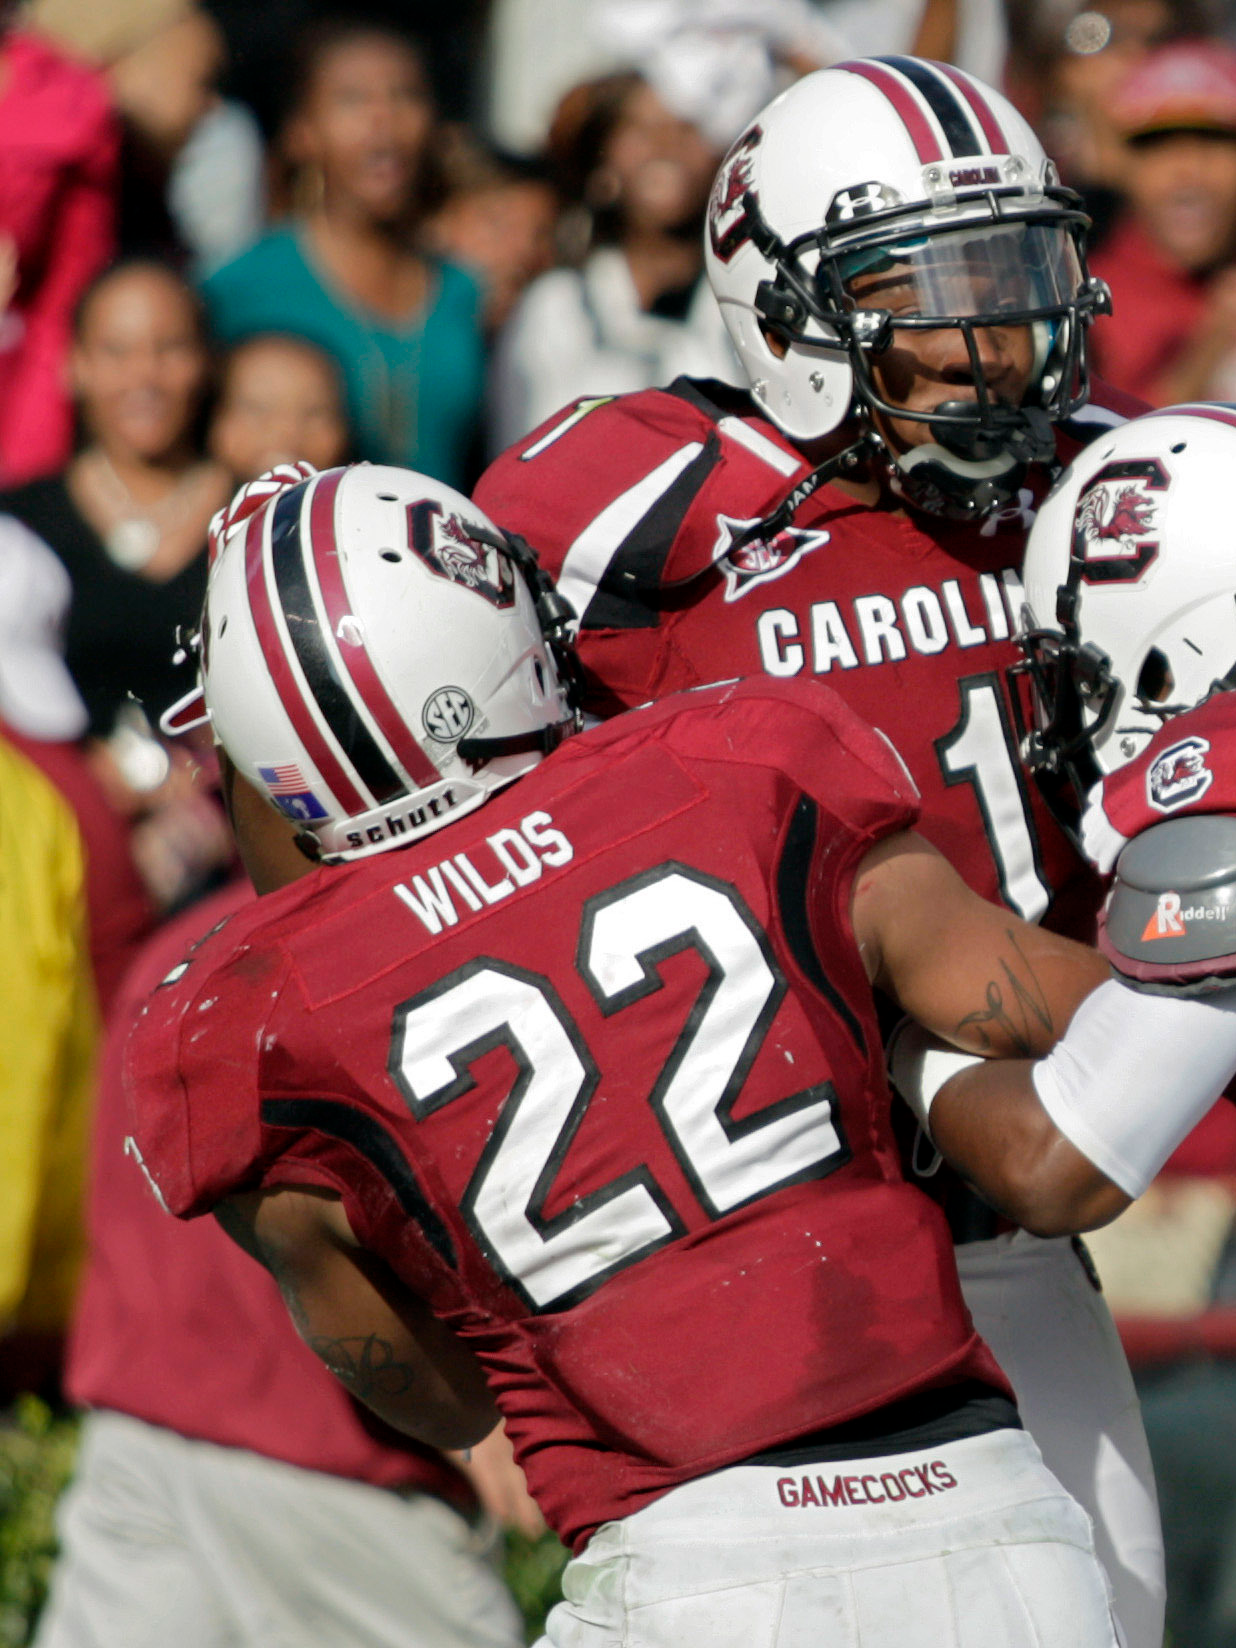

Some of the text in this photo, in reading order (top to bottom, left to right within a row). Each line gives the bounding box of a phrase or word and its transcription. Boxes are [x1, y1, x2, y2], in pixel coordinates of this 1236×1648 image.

[346, 785, 457, 849] schutt
[392, 809, 574, 936] WILDS
[1157, 891, 1226, 935] Riddell
[387, 857, 853, 1317] 22
[776, 1460, 958, 1509] GAMECOCKS
